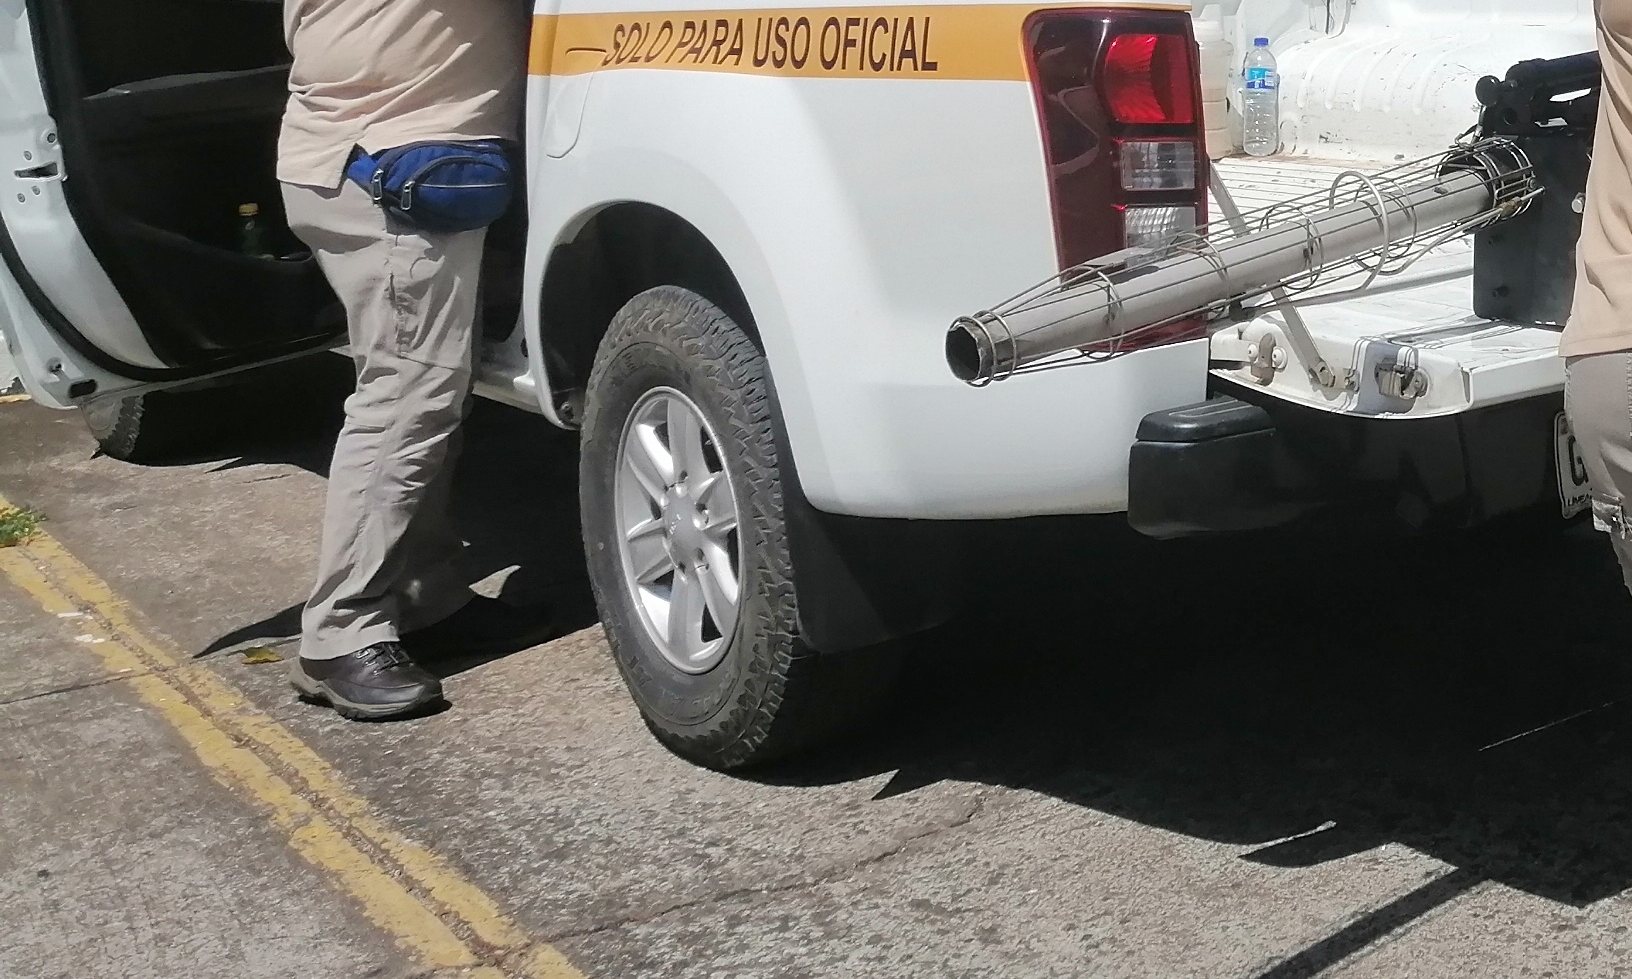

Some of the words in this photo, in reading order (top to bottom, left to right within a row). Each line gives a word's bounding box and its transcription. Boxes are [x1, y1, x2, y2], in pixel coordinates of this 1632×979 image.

[601, 20, 673, 67] SOLO
[667, 18, 743, 67] PARA
[752, 16, 811, 69] USO
[820, 16, 939, 72] OFICIAL
